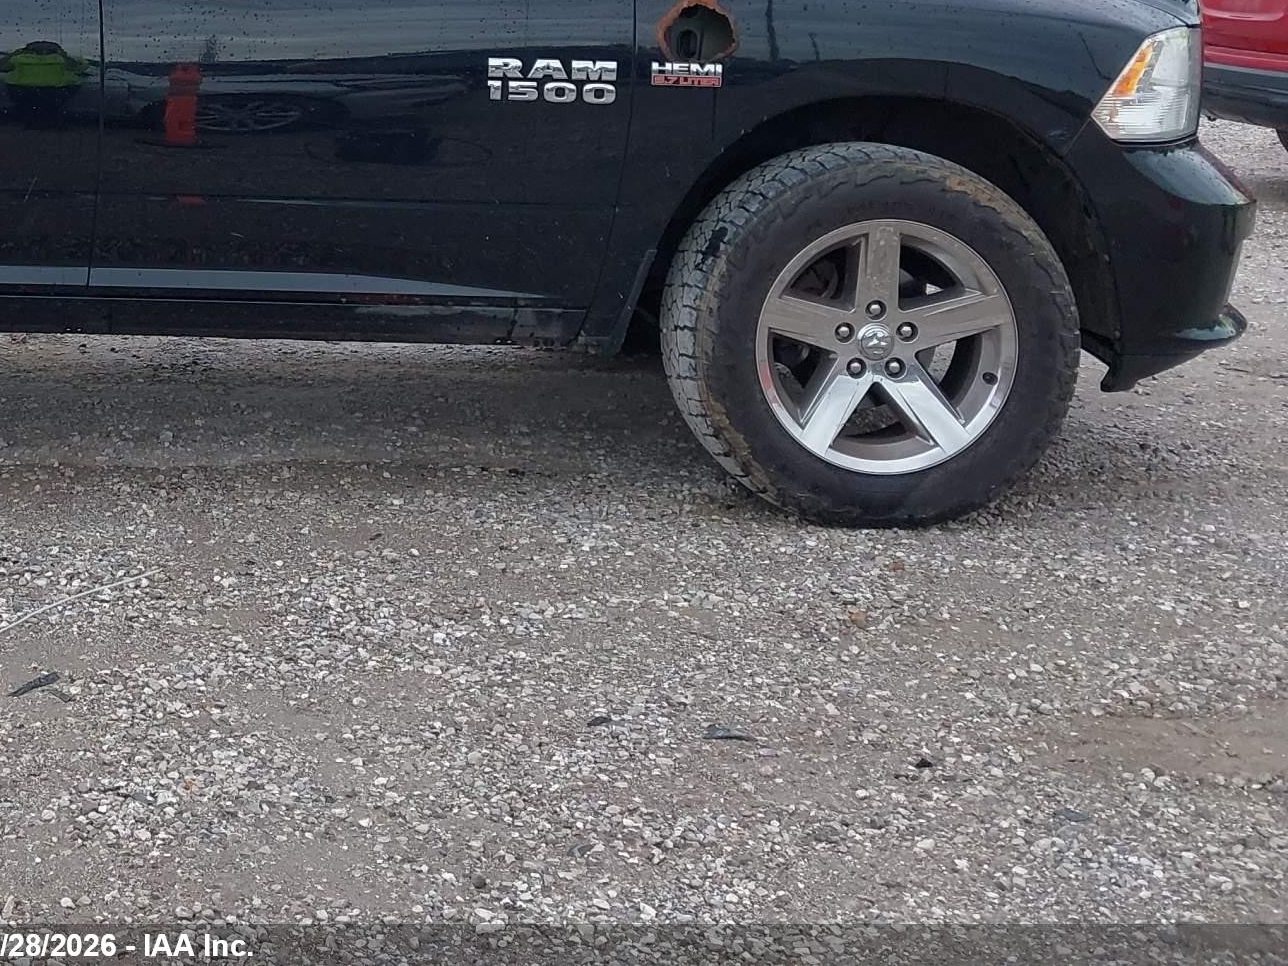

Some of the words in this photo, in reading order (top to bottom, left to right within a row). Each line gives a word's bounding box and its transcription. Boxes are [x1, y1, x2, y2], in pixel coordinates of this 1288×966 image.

[487, 57, 618, 81] RAM
[651, 61, 723, 76] HEMI
[487, 80, 617, 104] 1500
